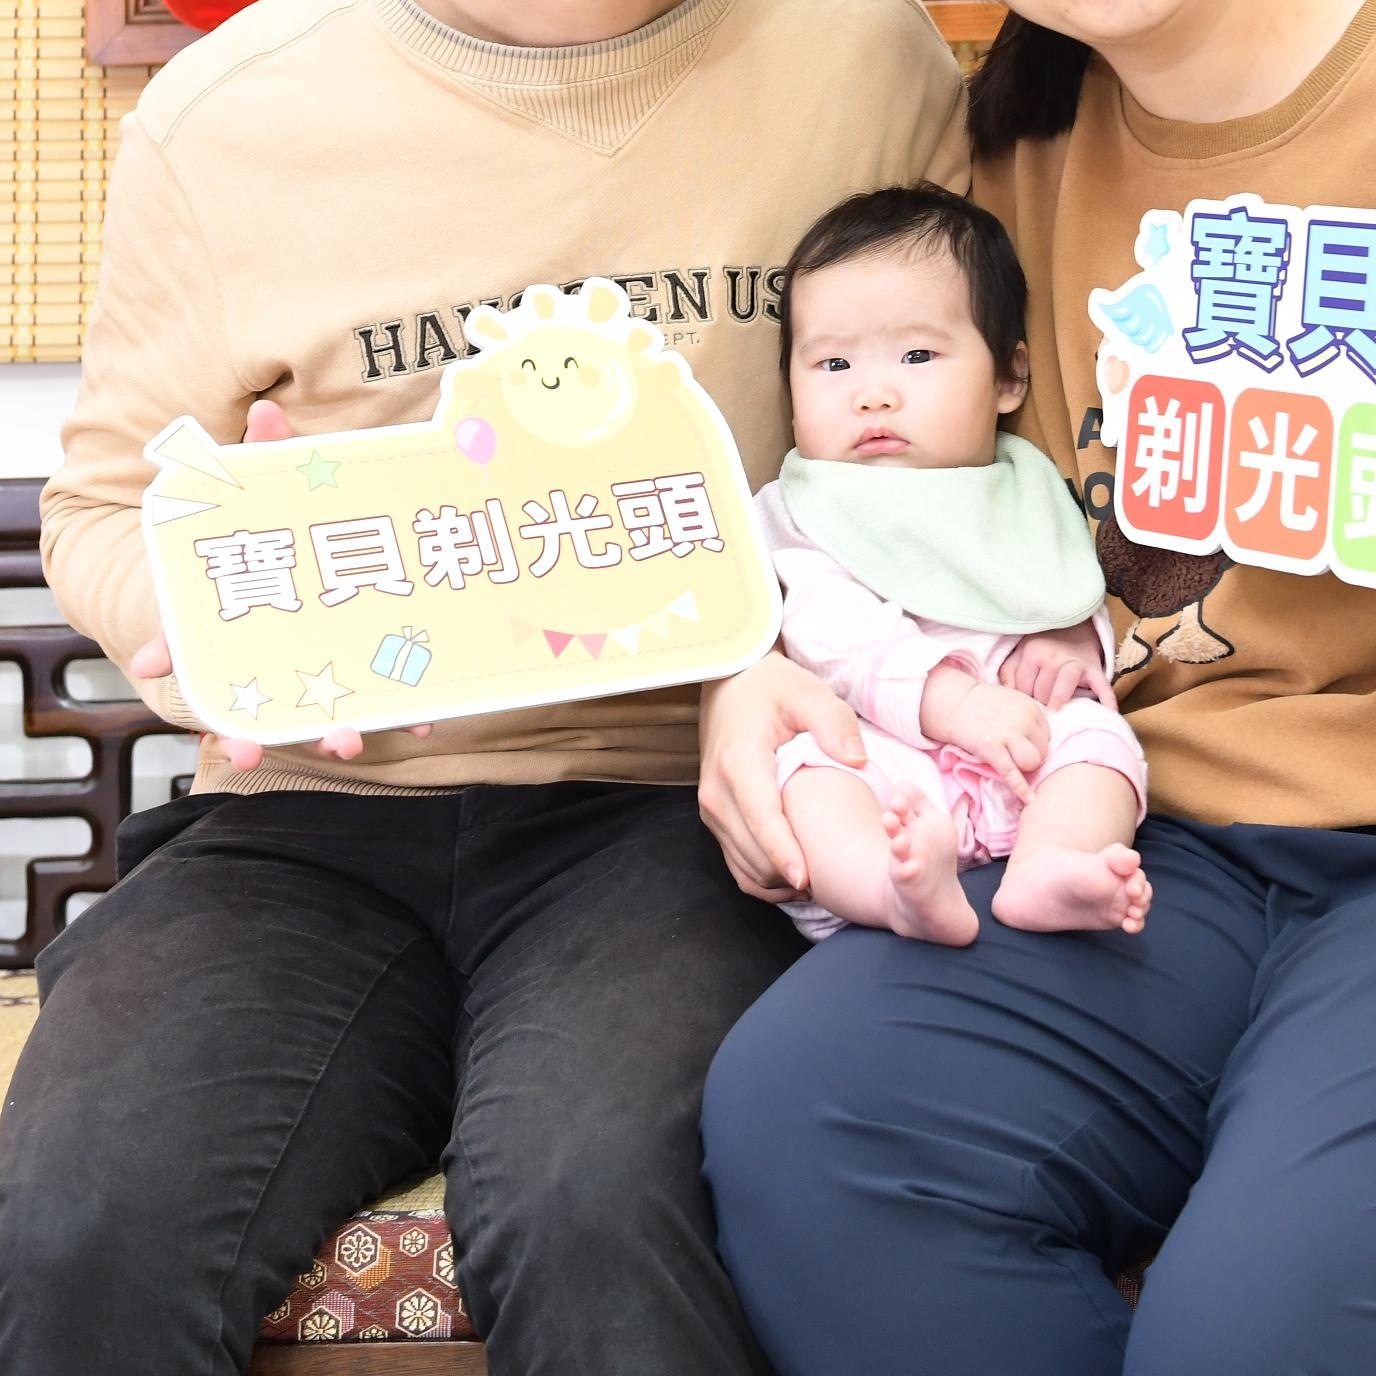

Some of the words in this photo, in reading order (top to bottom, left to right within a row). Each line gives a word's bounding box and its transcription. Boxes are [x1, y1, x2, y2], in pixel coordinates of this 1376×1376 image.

[194, 471, 725, 622] 寶貝剃光頭
